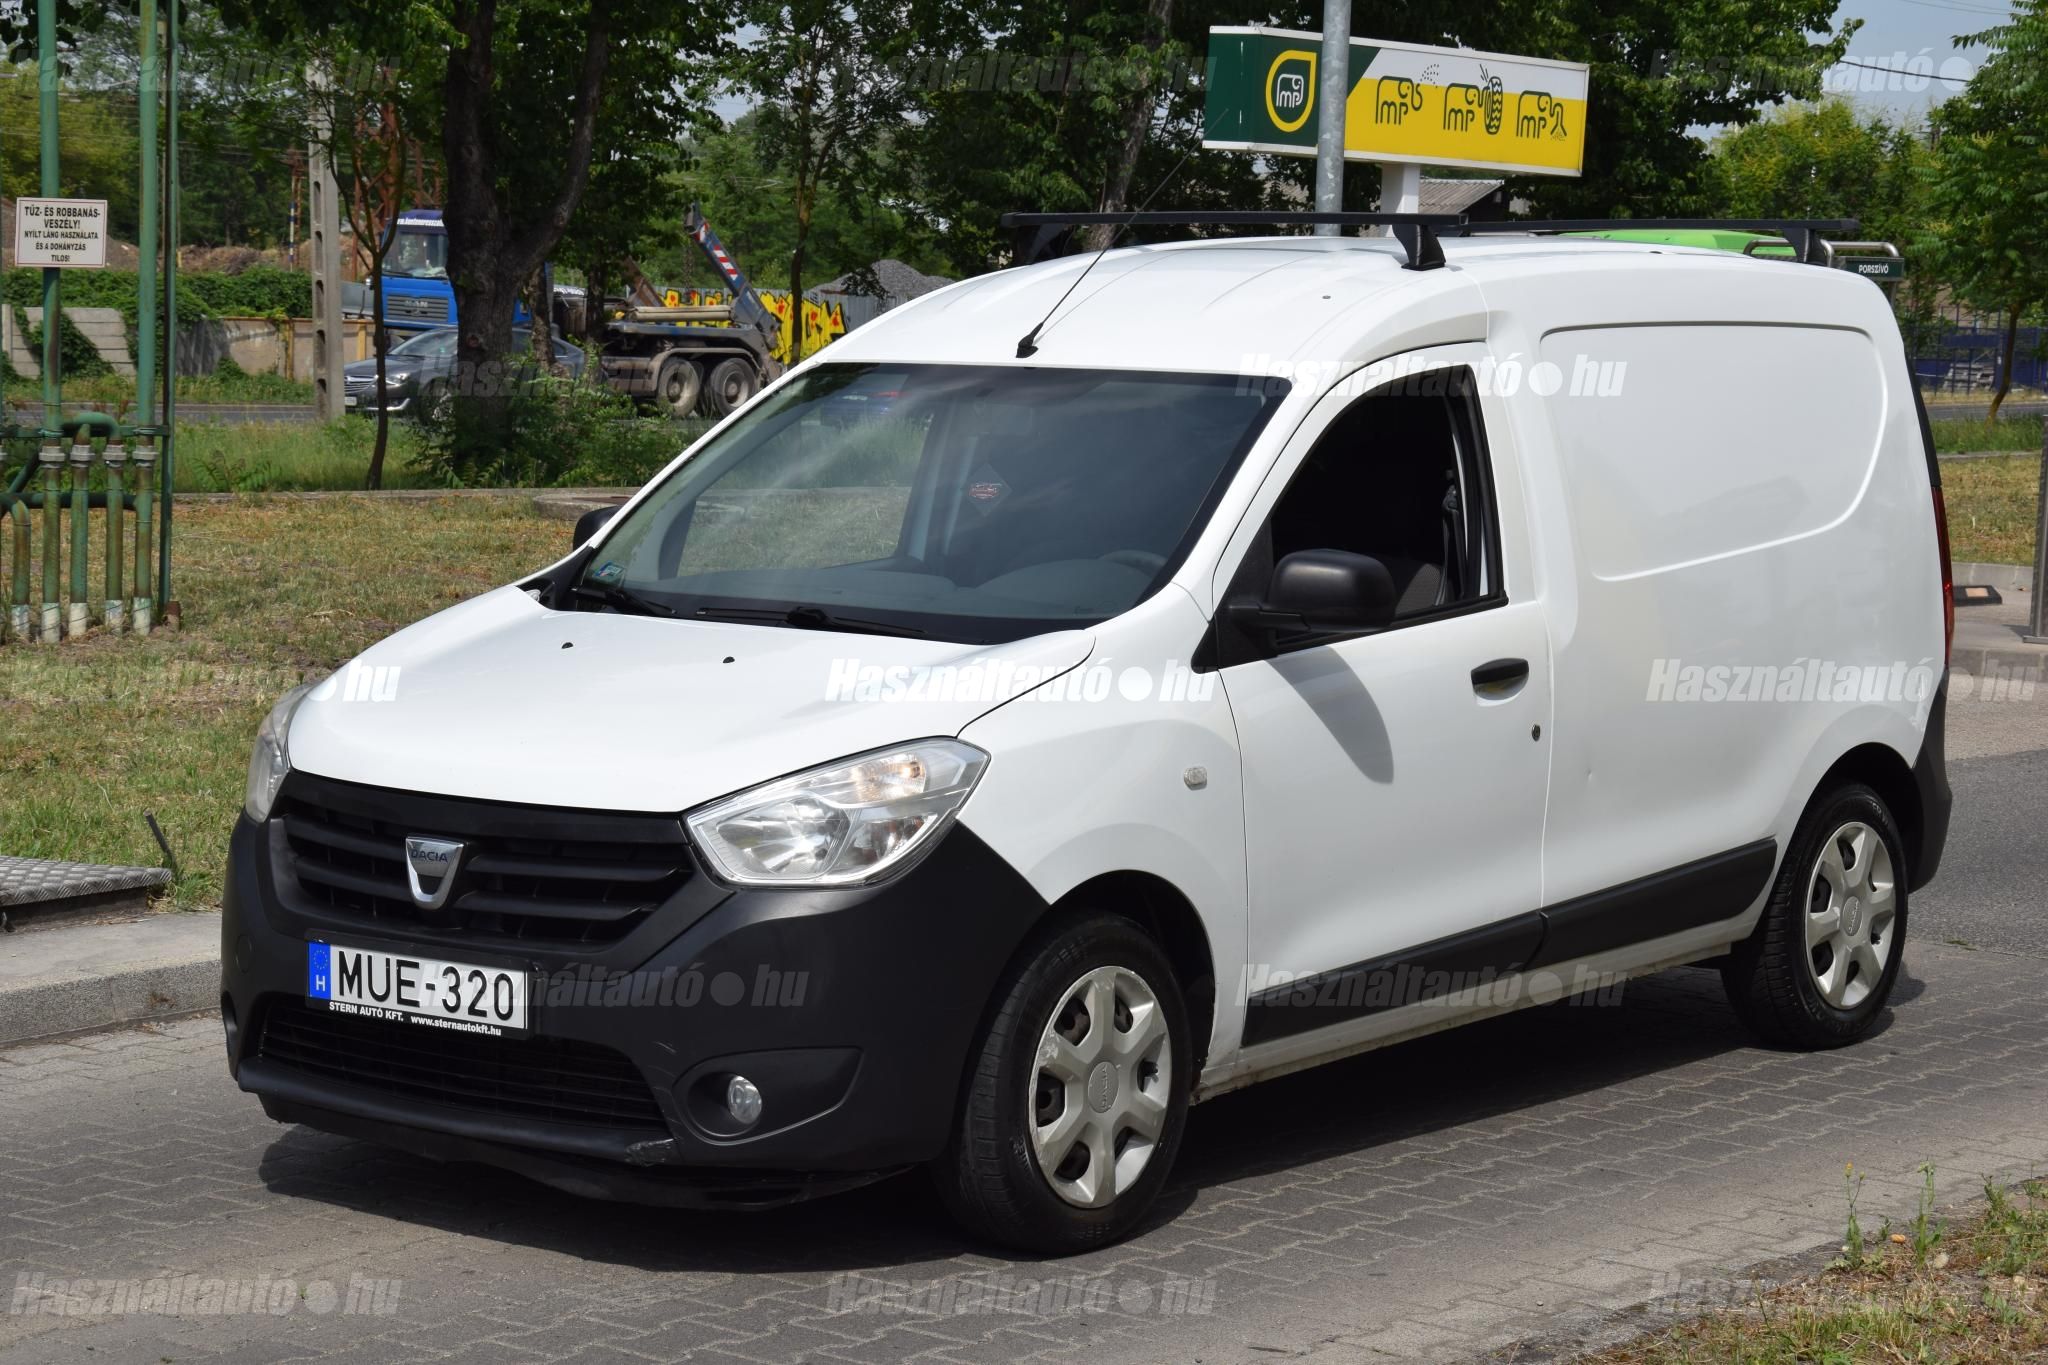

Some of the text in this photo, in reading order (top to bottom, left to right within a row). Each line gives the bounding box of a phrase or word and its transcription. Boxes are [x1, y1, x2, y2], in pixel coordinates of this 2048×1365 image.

[44, 205, 54, 217] ÉS
[44, 217, 81, 229] VESZÉLY!
[43, 230, 59, 239] LÁNG
[60, 230, 99, 240] HASZNÁLATA
[35, 242, 44, 250] ÉS
[50, 242, 86, 251] DOHÁNYZÁS
[1858, 263, 1889, 274] PORSZÍVÓ
[410, 849, 449, 864] DACIA
[315, 950, 514, 1021] H MUE-320
[329, 1002, 502, 1036] STERN AUTÓ KFT. www.sternautokft.hu
